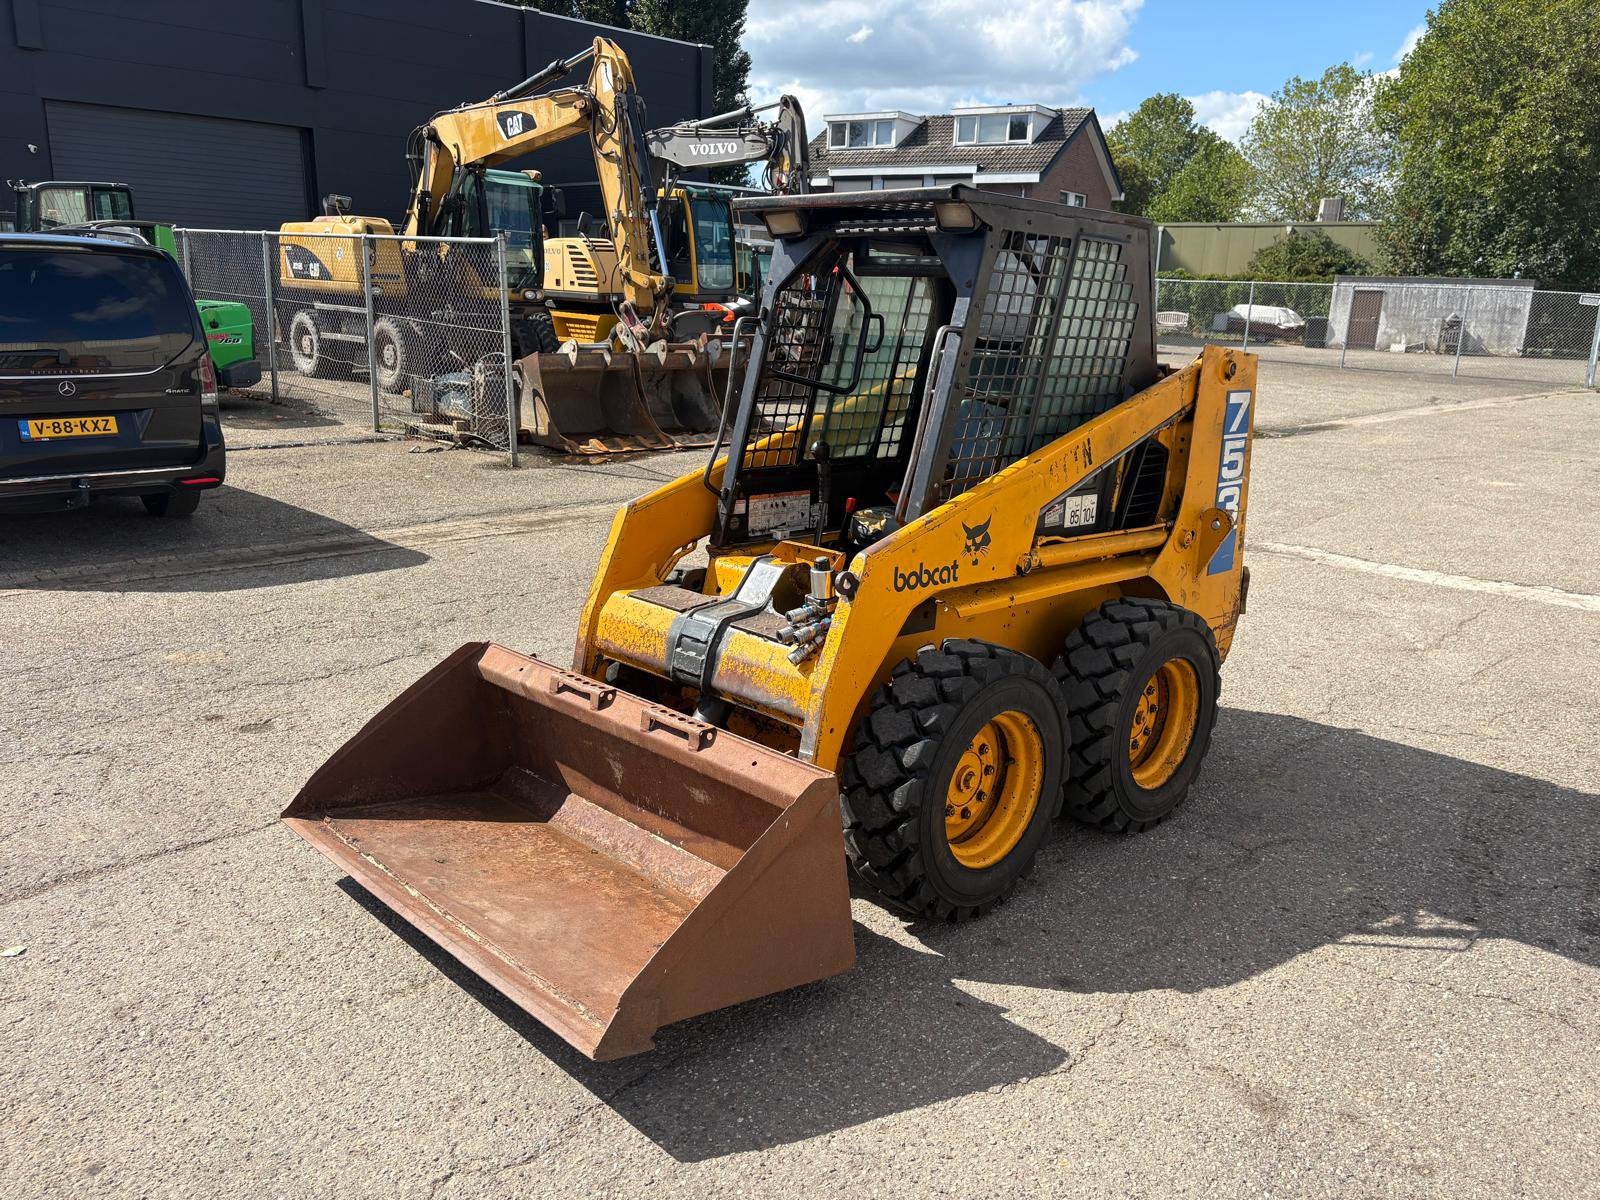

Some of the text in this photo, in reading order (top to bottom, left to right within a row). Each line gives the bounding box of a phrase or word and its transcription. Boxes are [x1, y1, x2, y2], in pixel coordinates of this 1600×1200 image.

[507, 113, 523, 137] CAT
[689, 142, 738, 155] VOLVO
[35, 419, 112, 435] V-88-KXZ
[1070, 509, 1080, 524] 85
[1083, 508, 1095, 523] 104
[893, 559, 959, 592] bobcat
